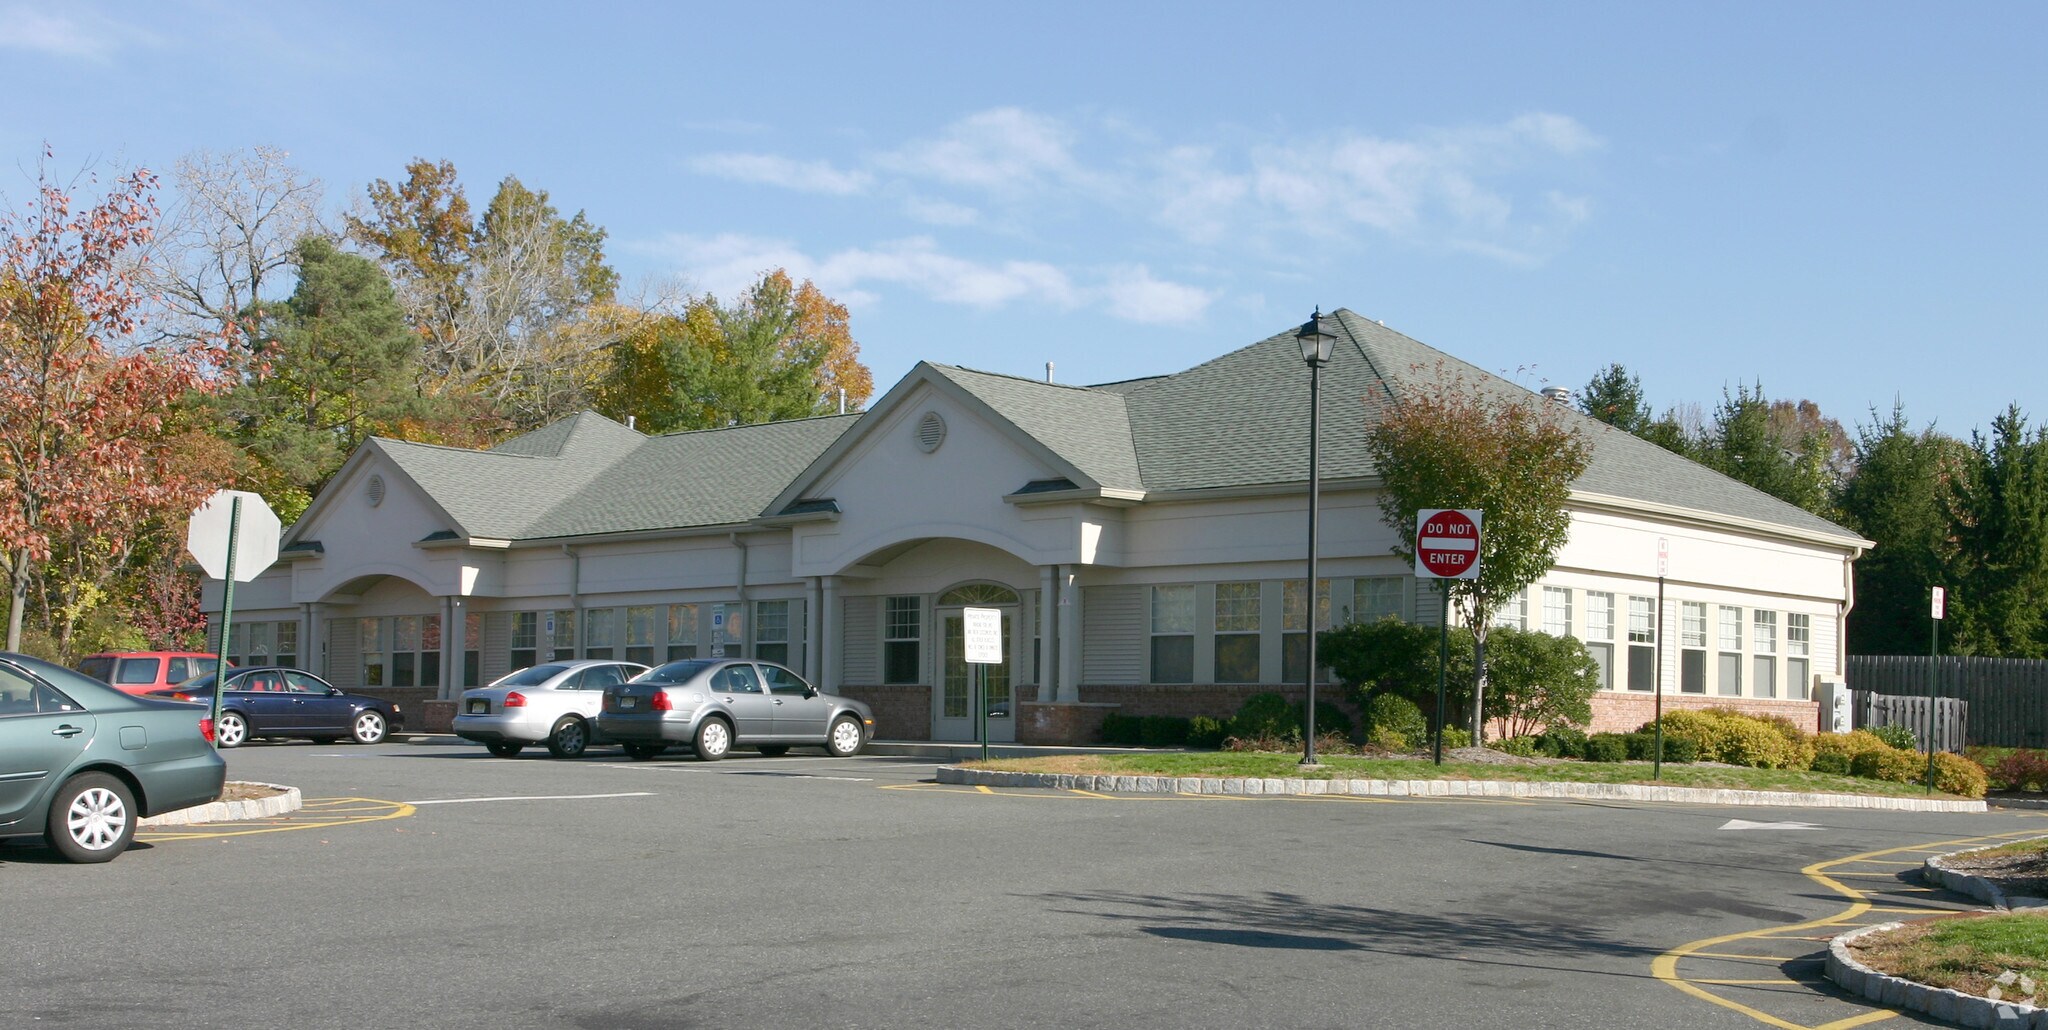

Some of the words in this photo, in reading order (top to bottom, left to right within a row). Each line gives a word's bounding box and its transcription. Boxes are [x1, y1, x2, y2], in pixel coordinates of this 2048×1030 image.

[1427, 523, 1443, 534] DO
[1449, 523, 1472, 535] NOT
[1430, 553, 1465, 565] ENTER
